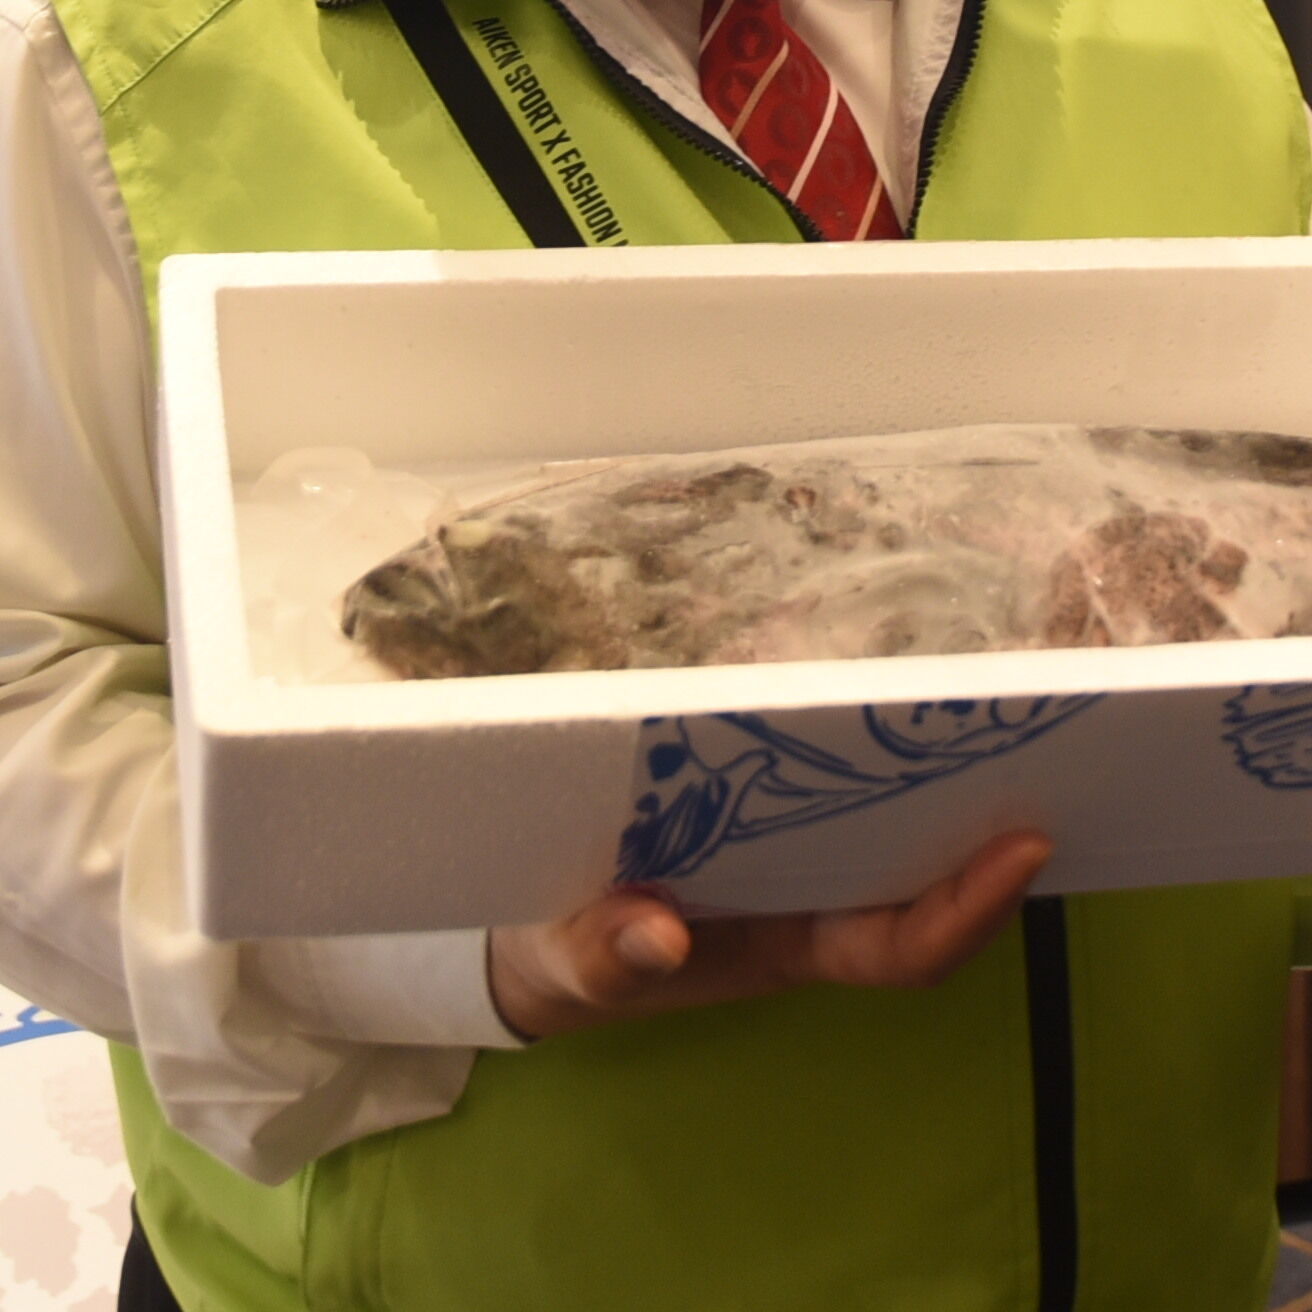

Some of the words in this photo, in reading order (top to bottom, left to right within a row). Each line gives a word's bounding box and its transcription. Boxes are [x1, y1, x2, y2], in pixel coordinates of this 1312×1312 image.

[472, 16, 525, 71] AIKEN
[504, 63, 562, 135] SPORT
[540, 129, 572, 156] X
[551, 147, 623, 244] FASHION
